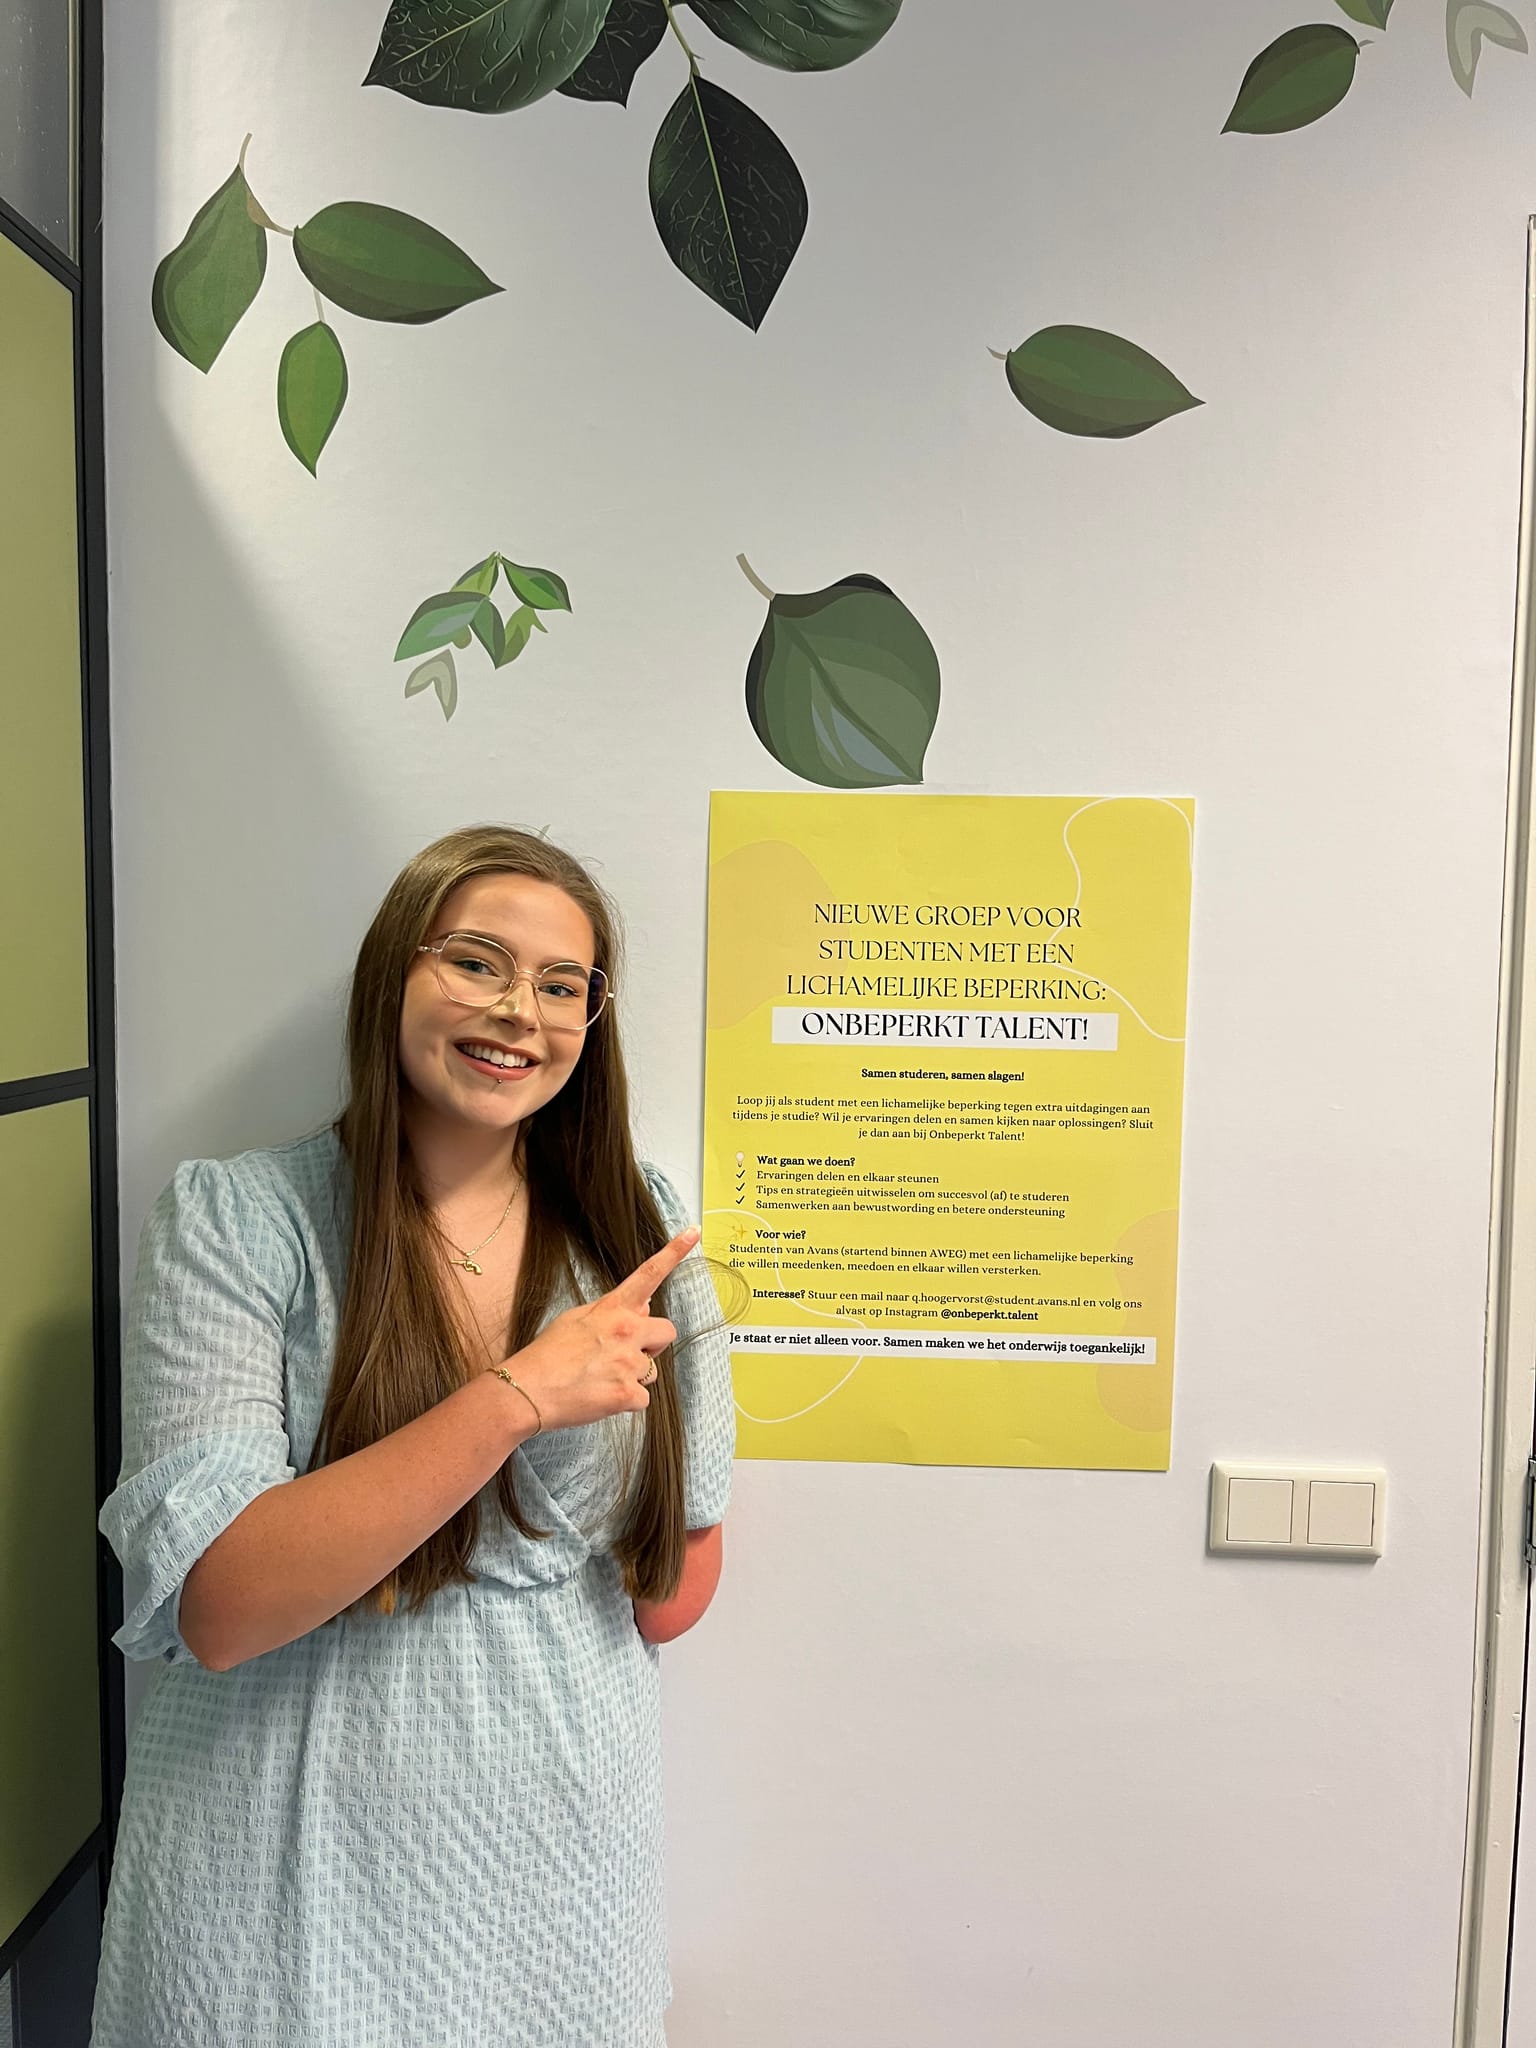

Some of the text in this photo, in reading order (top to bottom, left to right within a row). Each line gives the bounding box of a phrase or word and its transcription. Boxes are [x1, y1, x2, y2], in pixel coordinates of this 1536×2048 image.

[814, 902, 1082, 928] NIEUWE GROEP VOOR
[818, 938, 1074, 964] STUDENTEN MET EEN
[786, 974, 1106, 1001] LICHAMELIJKE BEPERKING:
[801, 1011, 1088, 1041] ONBEPERKT TALENT!
[861, 1067, 1025, 1084] Samen studeren, samen slagen!
[737, 1094, 1150, 1116] Loop jij als student met een lichamelijke beperking tegen extra uitdagingen aan
[732, 1108, 1154, 1131] tijdens je studie? Wil je ervaringen delen en samen kijken naar oplossingen? Sluit
[858, 1126, 1025, 1142] je dan aan bij Onbeperkt Talent!
[756, 1154, 856, 1168] Wat gaan we doen?
[757, 1169, 939, 1184] Ervaringen delen en elkaar steunen
[755, 1183, 1070, 1202] Tips en strategieën uitwisselen om succesvol (af) te studeren
[755, 1198, 1066, 1219] Samenwerken aan bewustwording en betere ondersteuning
[754, 1228, 806, 1240] Voor wie?
[729, 1242, 1134, 1266] Studenten van Avans (startend binnen AWEG) met een lichamelijke beperking
[728, 1257, 1041, 1276] die willen meedenken, meedoen en elkaar willen versterken.
[752, 1287, 1142, 1311] Interesse? Stuur een mail naar q.hoogervorst@student.avans.nl en volg ons
[836, 1304, 1039, 1321] alvast op Instagram @onbeperkt.talent
[729, 1331, 1145, 1356] Je staat er niet alleen voor. Samen maken we het onderwijs toegankelijk!
